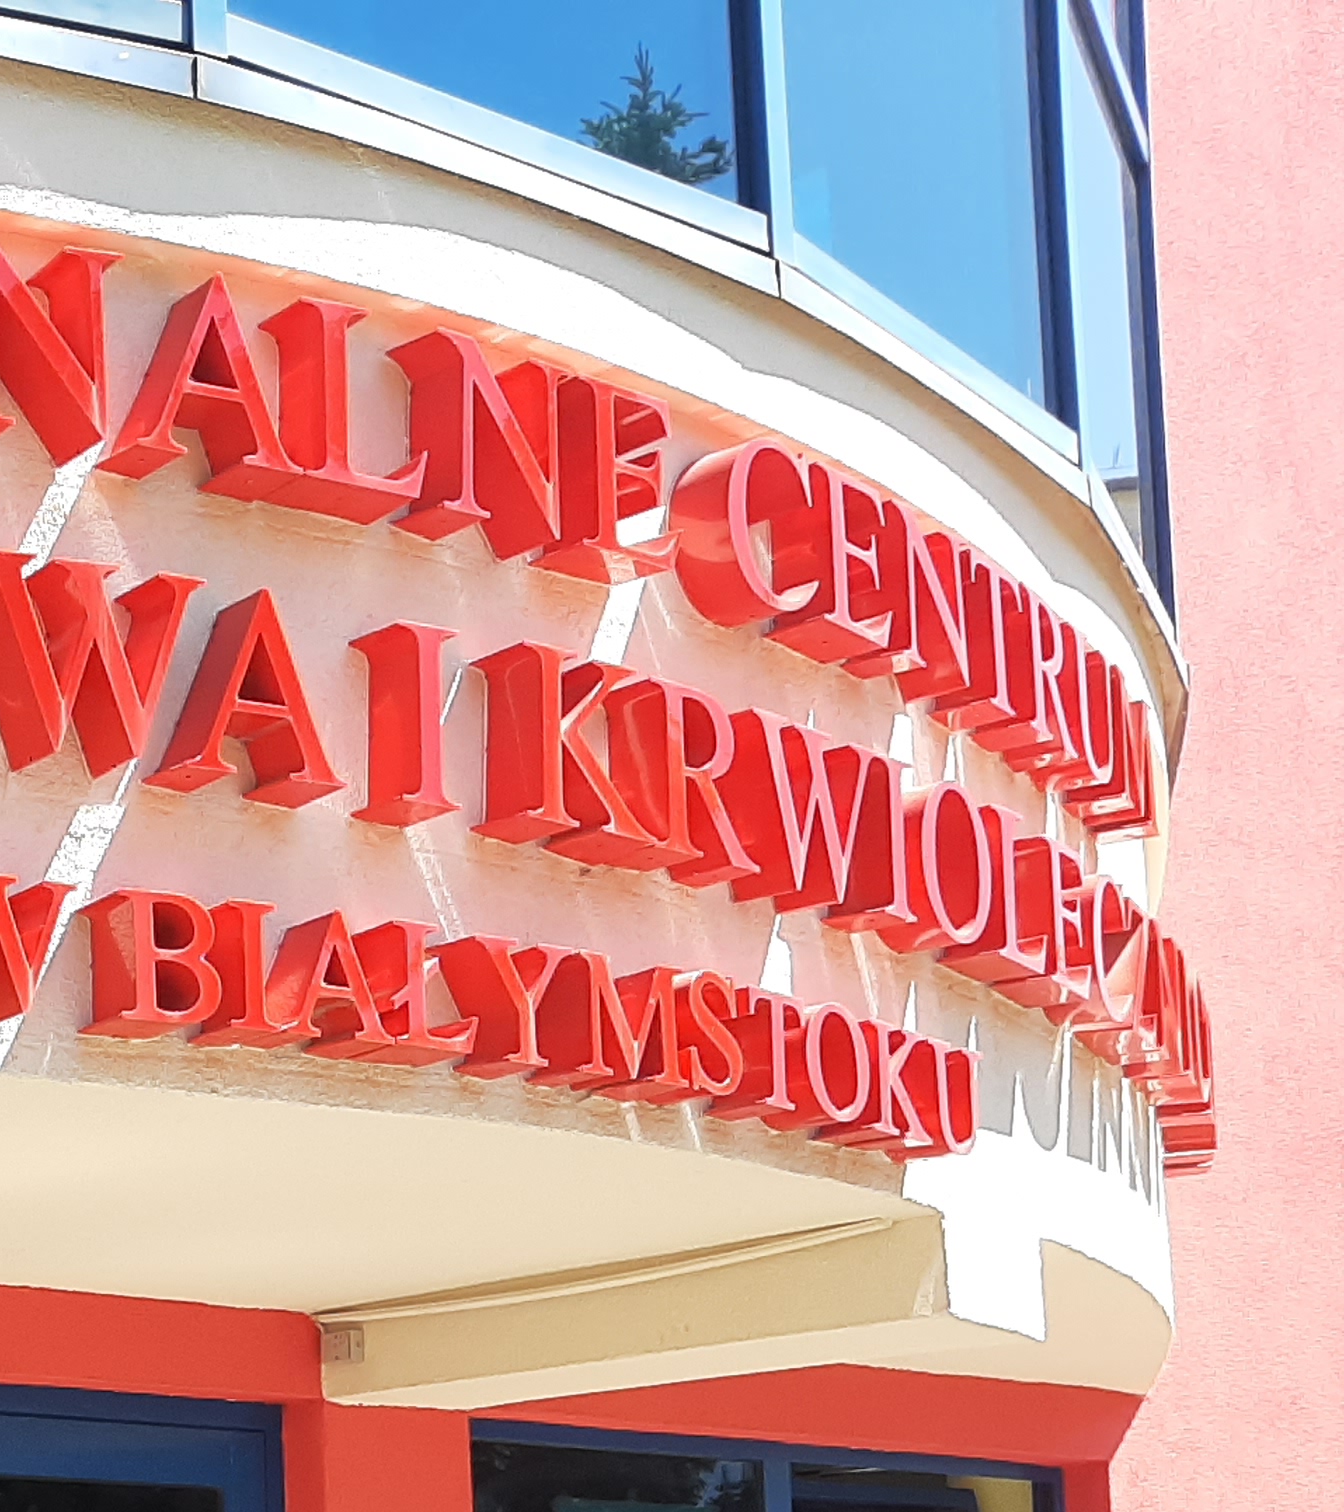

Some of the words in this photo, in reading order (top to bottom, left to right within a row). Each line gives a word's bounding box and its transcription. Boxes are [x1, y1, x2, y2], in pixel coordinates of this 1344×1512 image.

[349, 620, 460, 828] I
[665, 437, 1160, 845] CENTRUM
[75, 888, 982, 1165] BIAŁYMSTOKU
